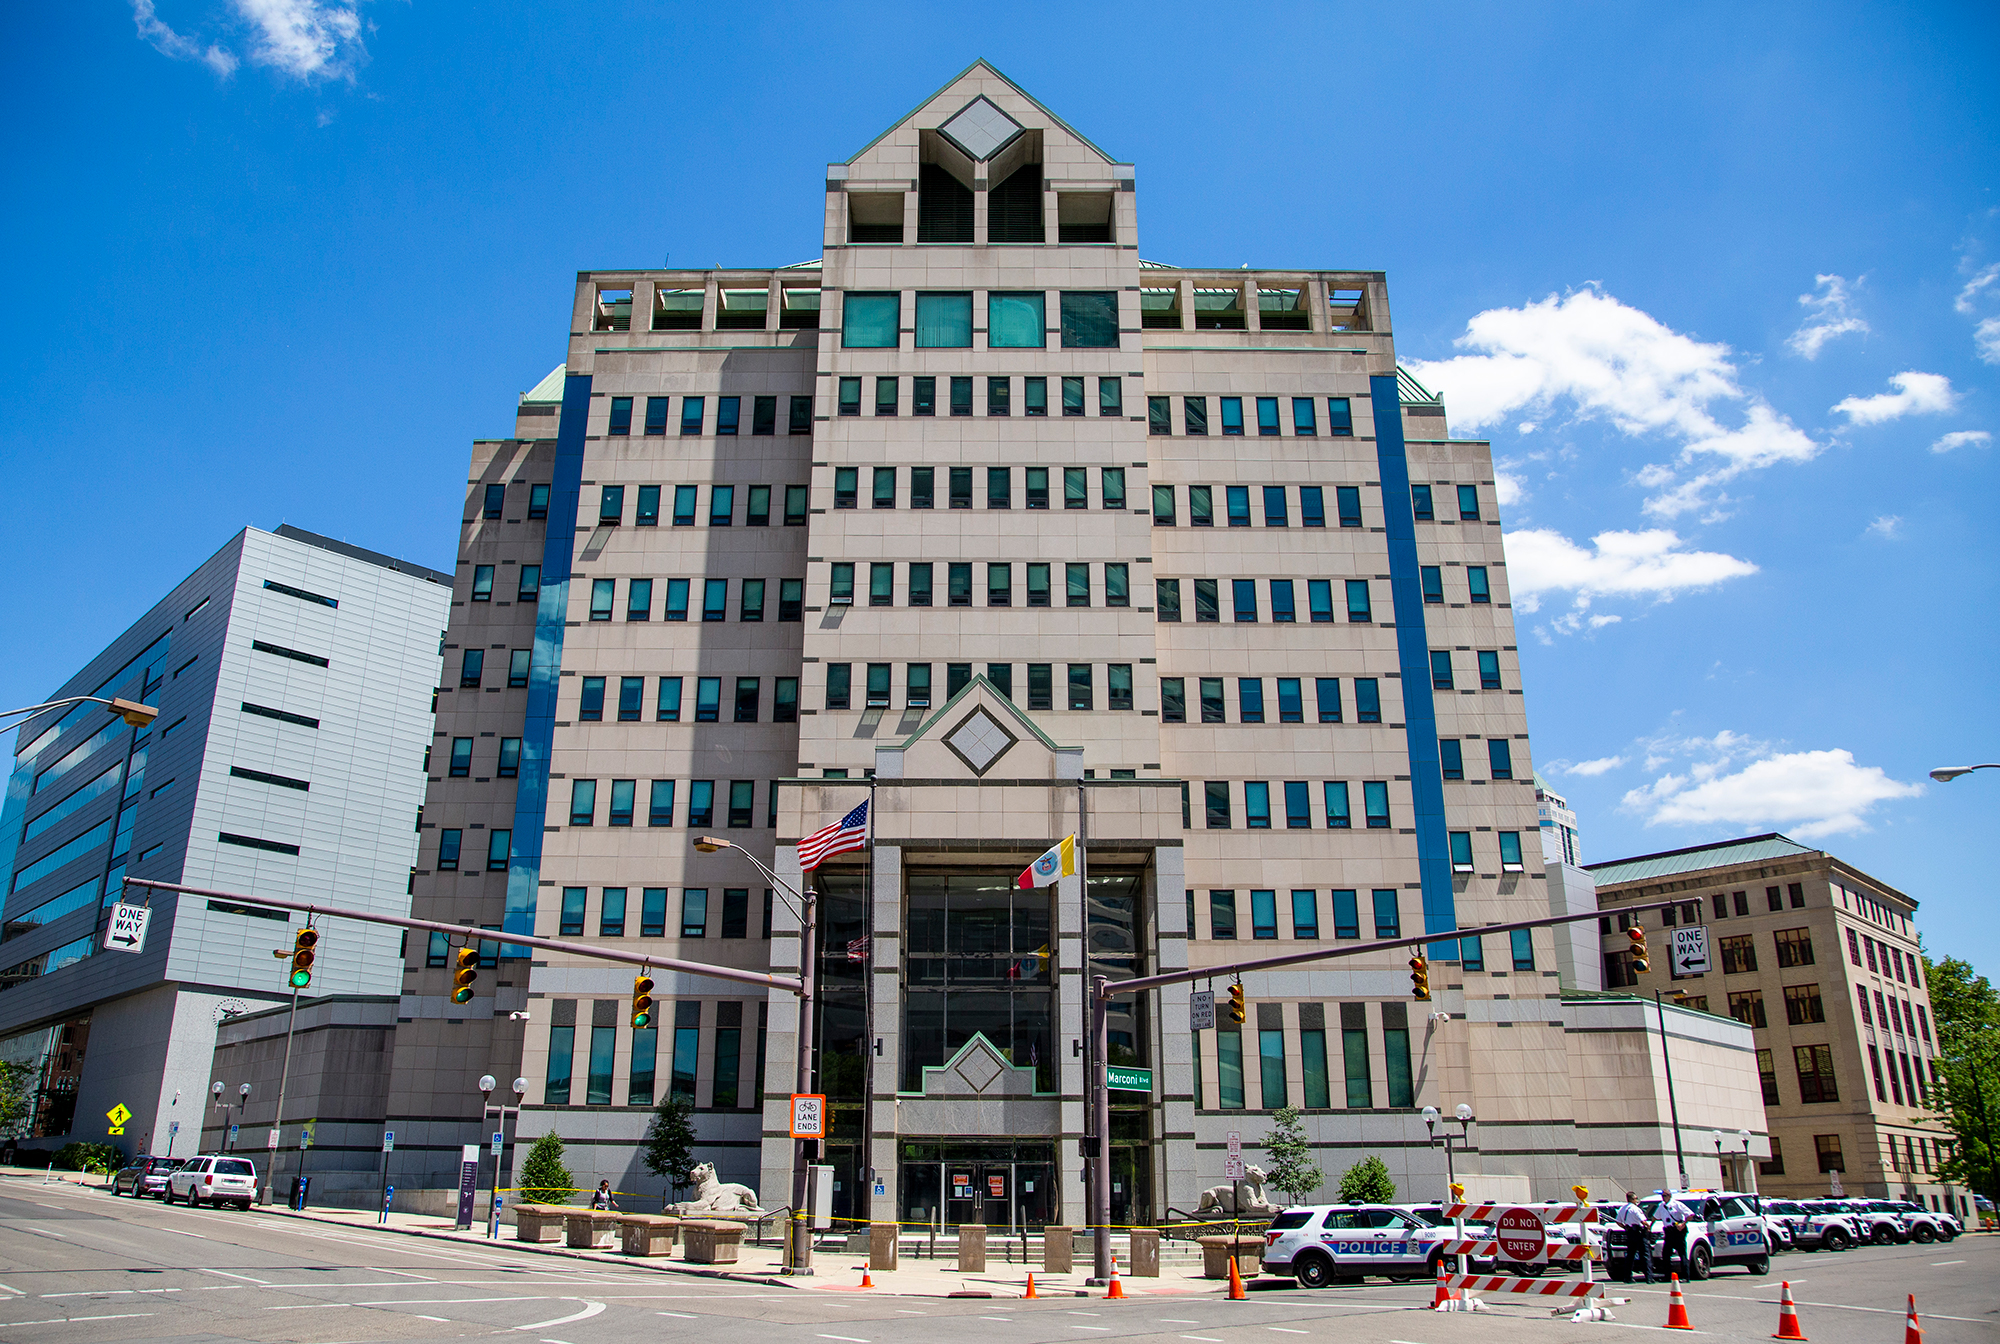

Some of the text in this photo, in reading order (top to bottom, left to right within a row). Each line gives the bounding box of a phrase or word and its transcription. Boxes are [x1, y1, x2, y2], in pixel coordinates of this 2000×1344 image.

[119, 908, 144, 921] ONE
[116, 919, 143, 932] WAY
[1677, 930, 1702, 942] ONE
[1677, 942, 1703, 954] WAY
[1108, 1072, 1138, 1085] Marconi
[797, 1113, 818, 1121] LANE
[797, 1122, 818, 1130] ENDS
[1242, 1224, 1270, 1232] POLIC
[1502, 1217, 1537, 1228] DO NOT
[1338, 1241, 1401, 1254] POLICE
[1507, 1241, 1536, 1252] ENTER
